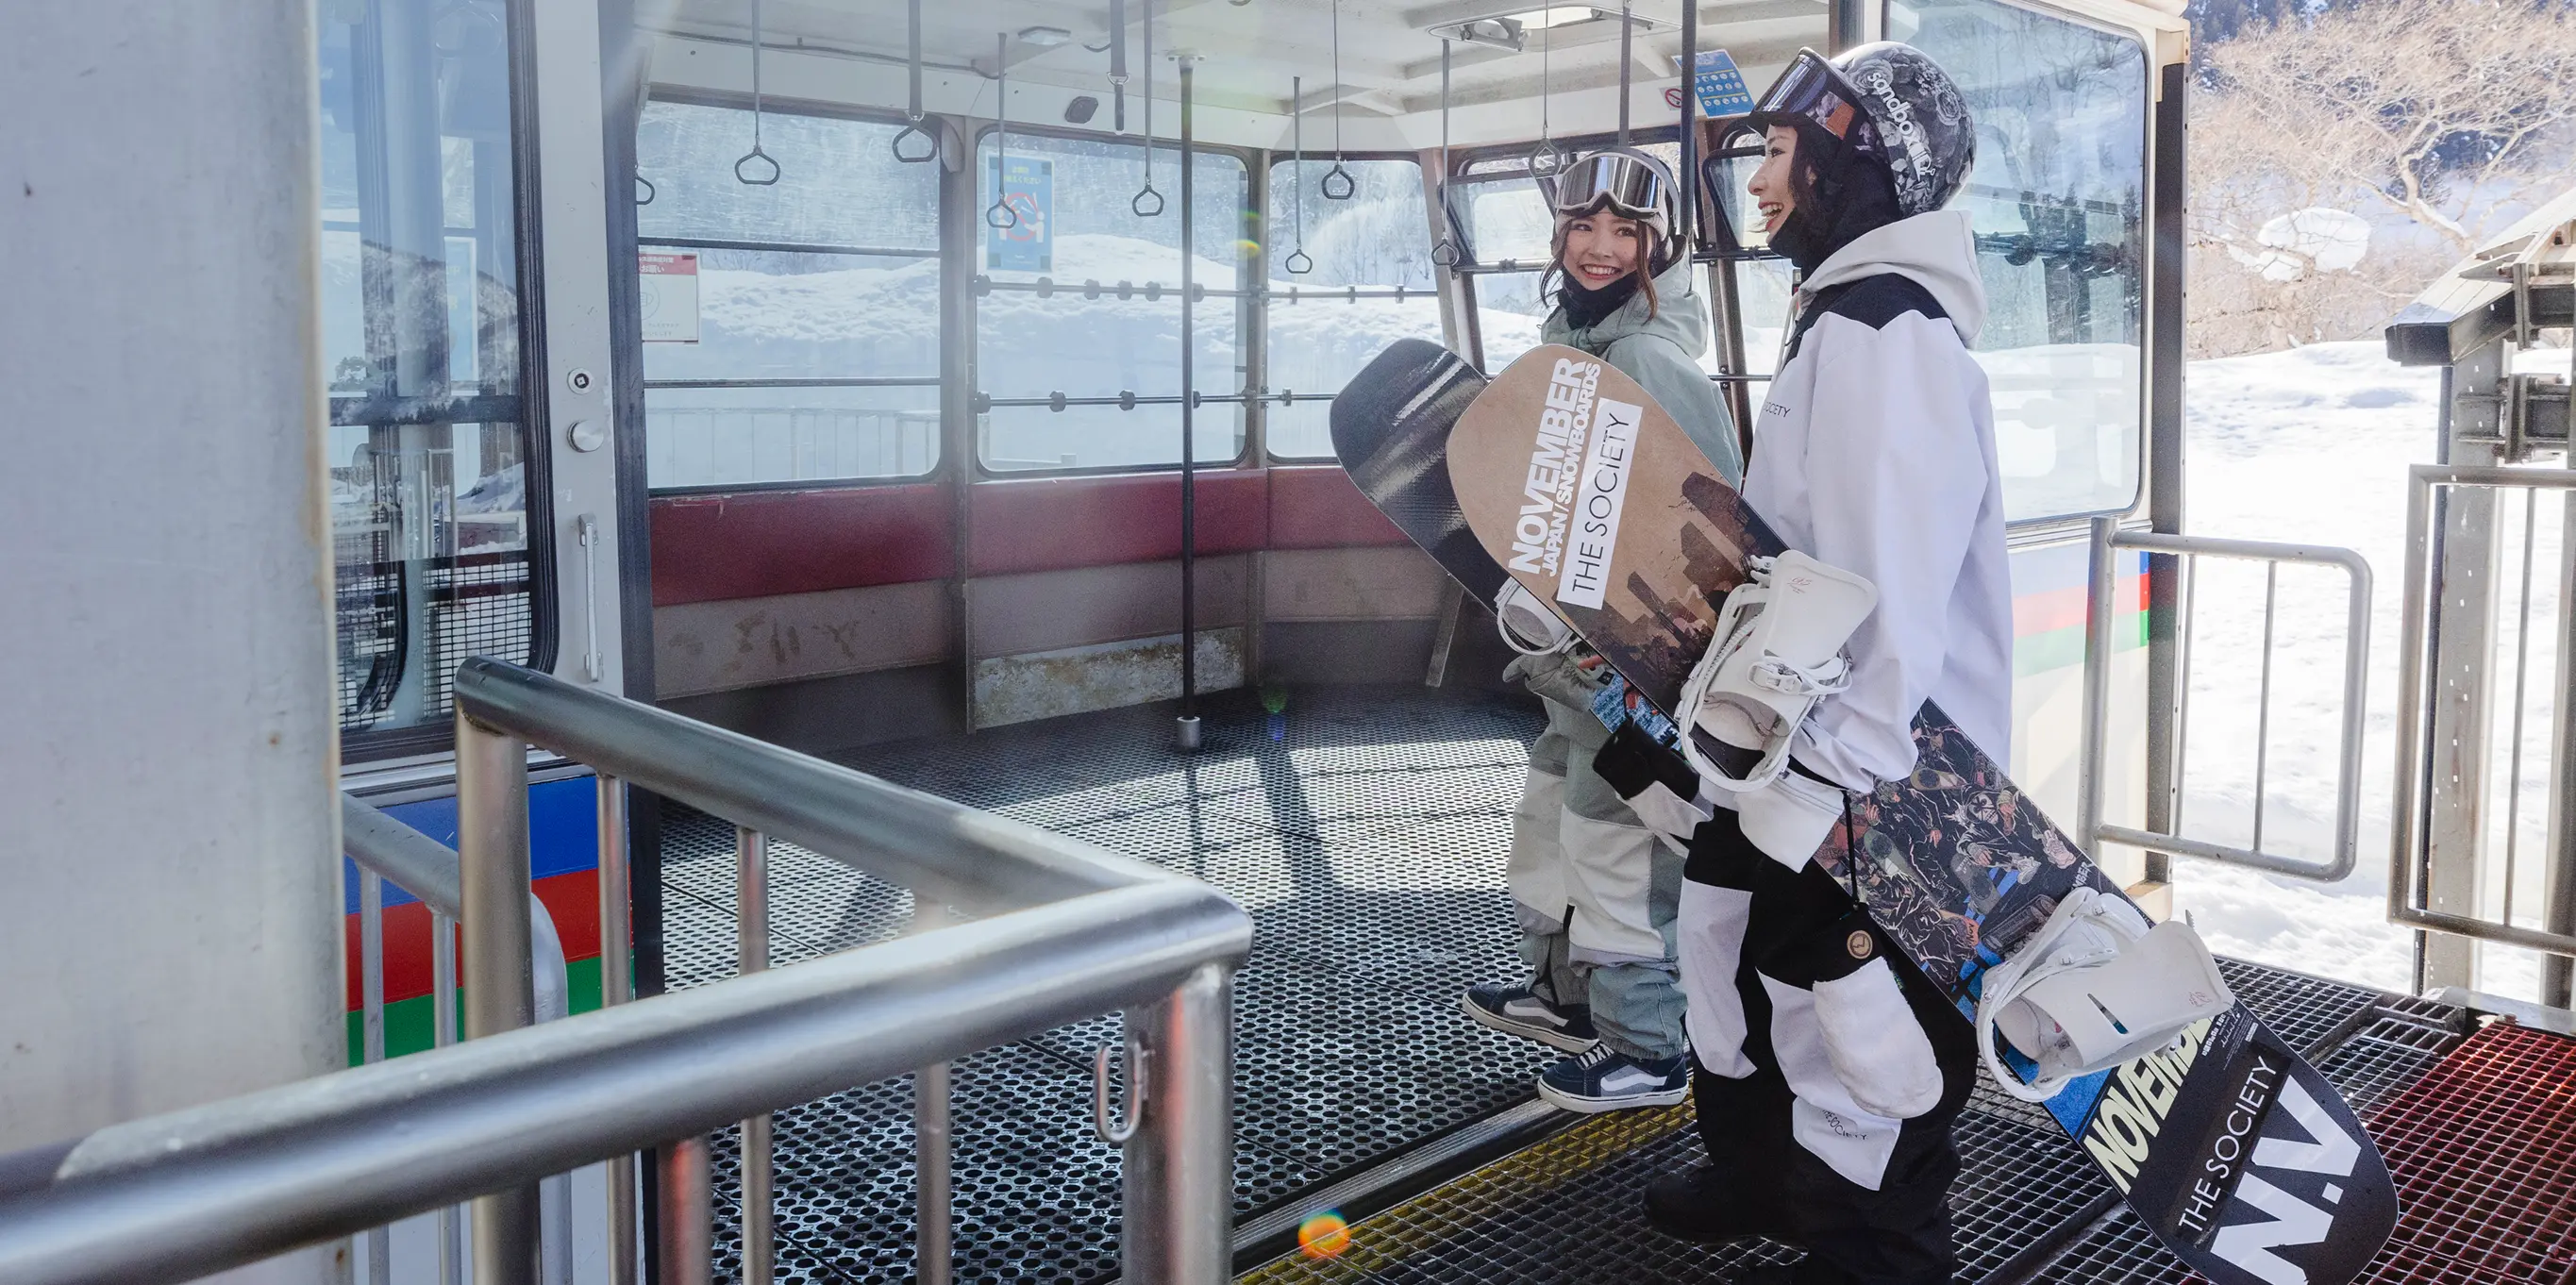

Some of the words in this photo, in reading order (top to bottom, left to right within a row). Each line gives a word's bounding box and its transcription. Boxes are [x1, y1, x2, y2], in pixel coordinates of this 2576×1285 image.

[1508, 358, 1587, 575] NOVEMBER
[1584, 412, 1630, 537] SOCIETY
[1572, 542, 1604, 592] THE
[2083, 1014, 2215, 1195] NOVEMB
[2178, 1177, 2221, 1231] THE
[2205, 1056, 2277, 1178] SOCIETY
